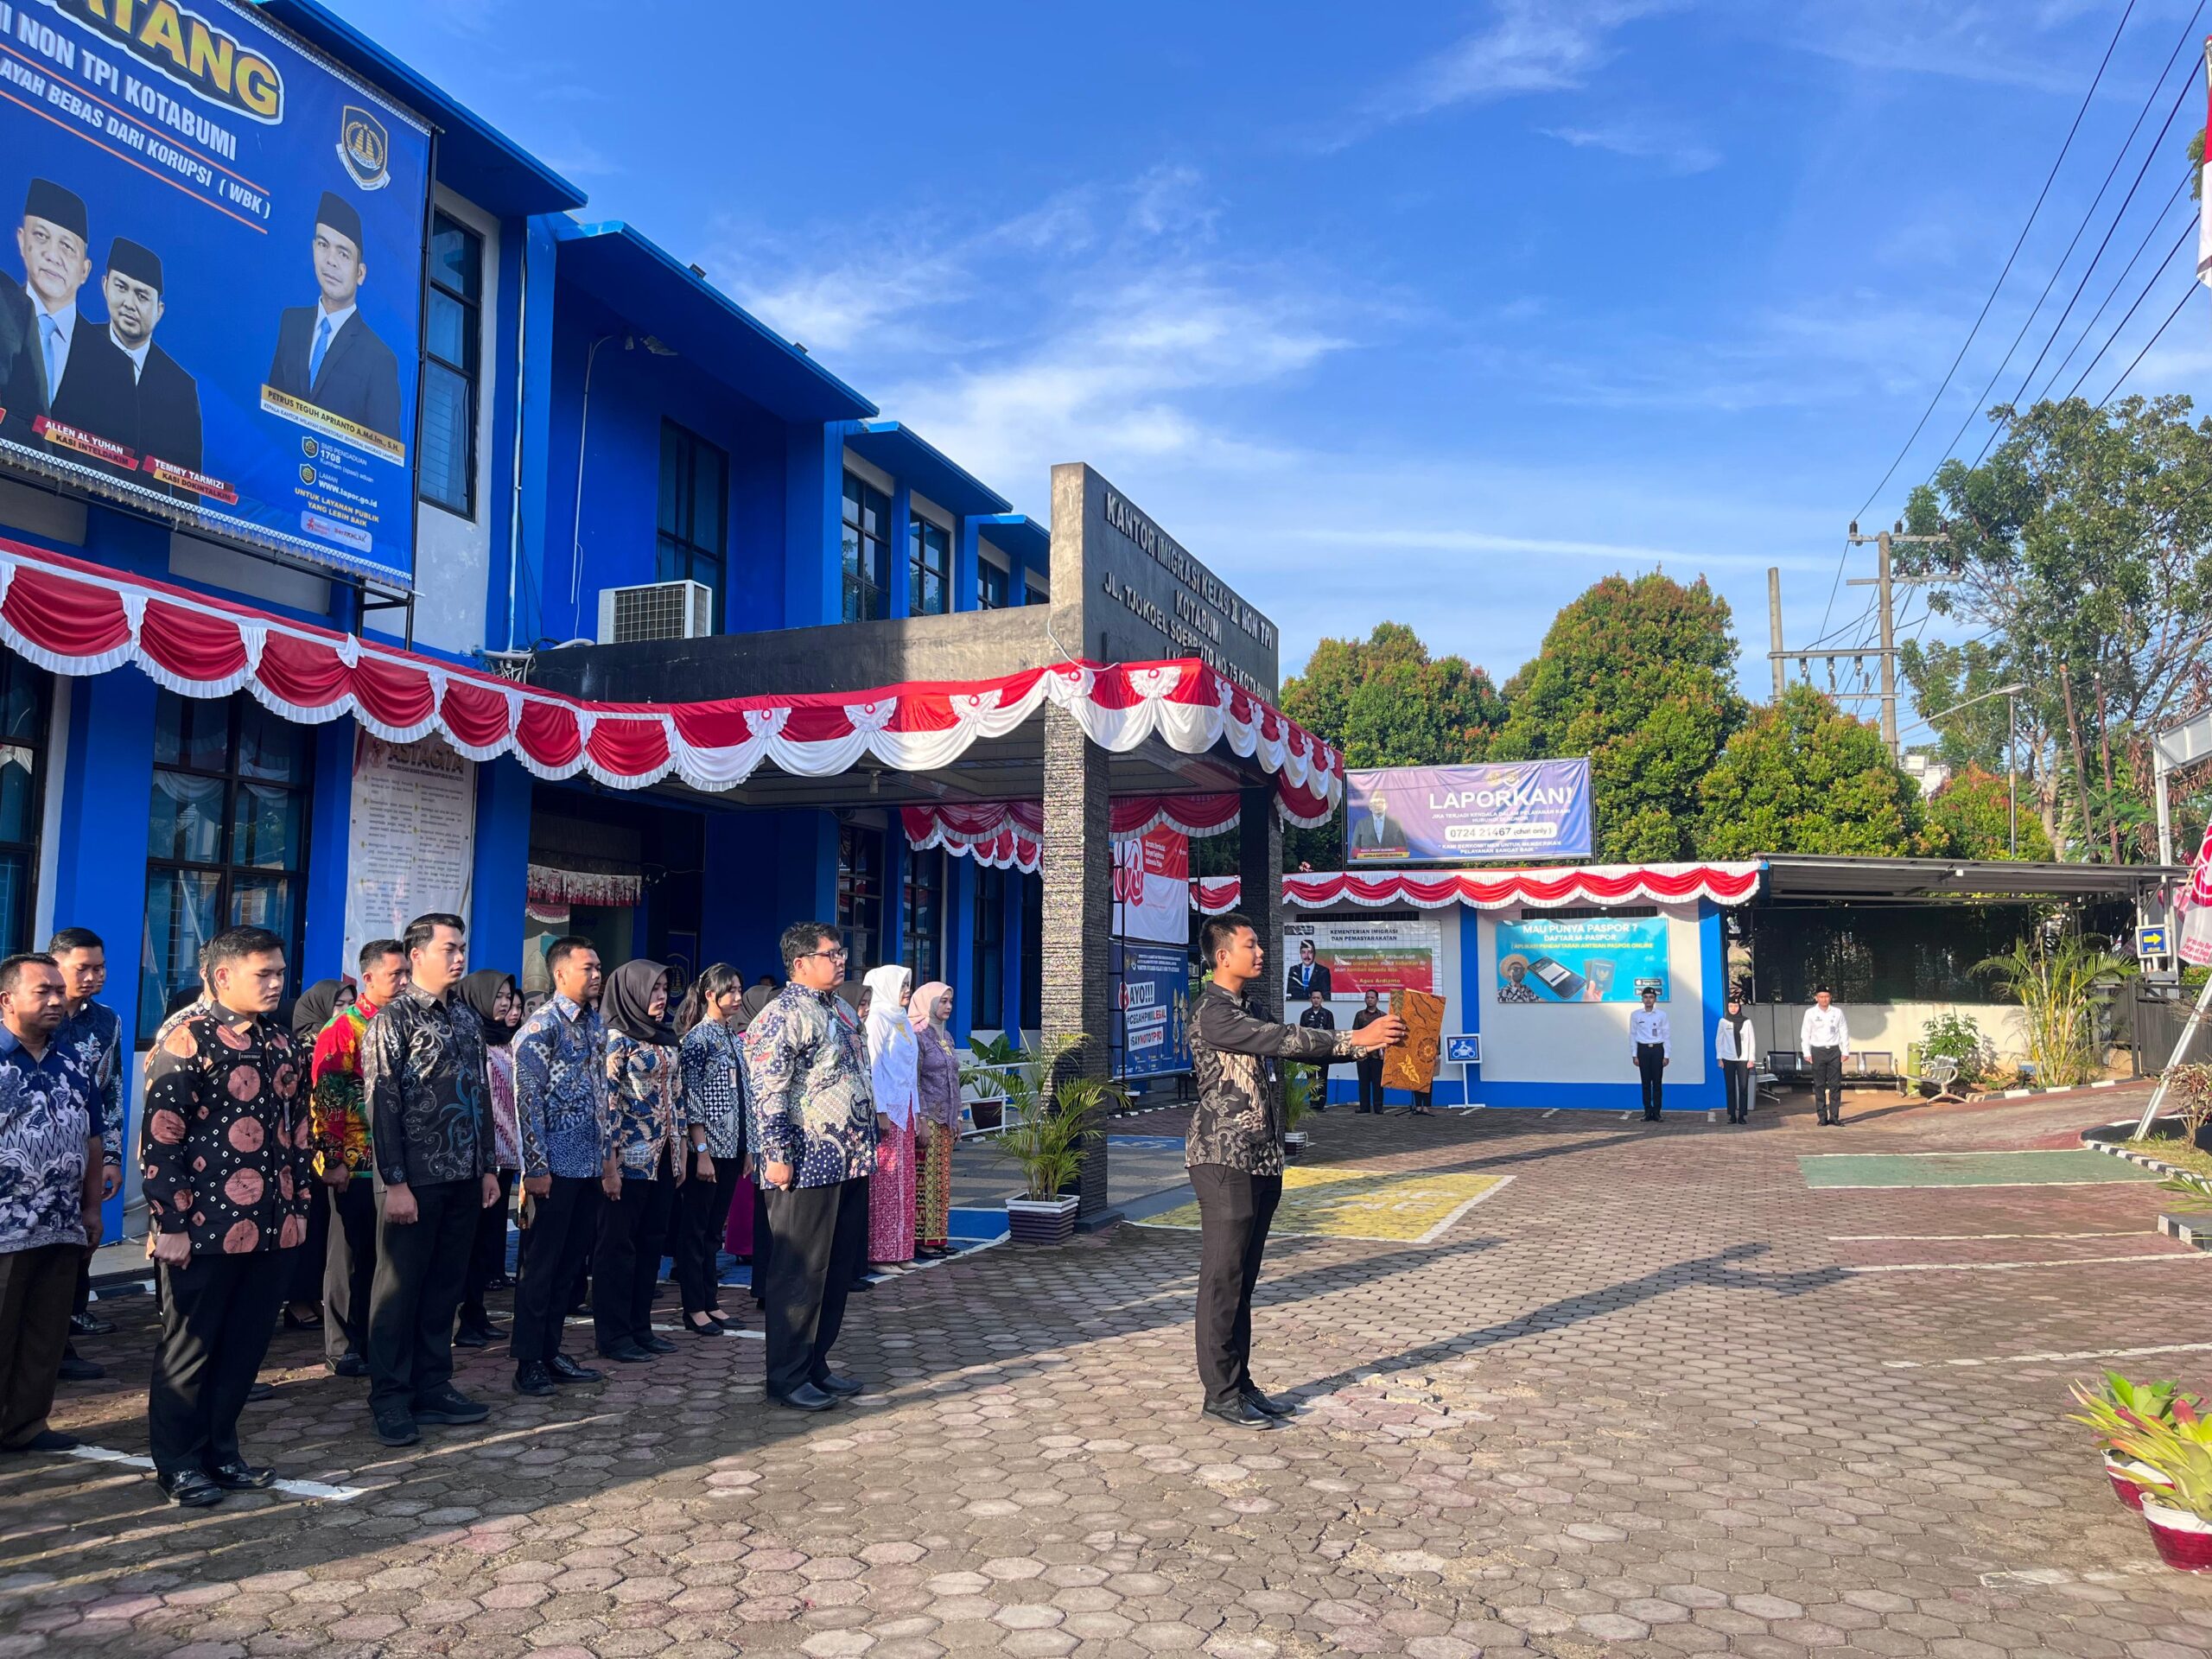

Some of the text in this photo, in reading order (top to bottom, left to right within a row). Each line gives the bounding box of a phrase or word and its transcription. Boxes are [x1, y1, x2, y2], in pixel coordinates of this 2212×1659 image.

[18, 11, 75, 71] NON
[82, 48, 119, 96] TPI
[125, 74, 237, 162] KOTABUMI
[48, 83, 105, 128] BEBAS
[105, 115, 145, 152] DARI
[147, 138, 213, 188] KORUPSI
[268, 390, 294, 407] PETRUS
[296, 401, 320, 418] TEGUH
[321, 413, 355, 432] APRIANTO
[45, 421, 124, 454] ALLEN AL YUHAN
[55, 434, 129, 465] KASI INTELDAKIM
[321, 449, 341, 464] 1708
[334, 447, 367, 467] PENGADUAN
[154, 458, 225, 490] TEMMY TARMIZI
[162, 473, 231, 501] KASI DOKINTALKIM
[319, 471, 339, 484] LAMAN
[295, 486, 379, 524] UNTUK LAYANAN PUBLIK
[308, 500, 367, 527] YANG LEBIH BAIK
[1107, 492, 1154, 556] KANTOR
[1158, 535, 1199, 594] IMIGRASI
[1202, 574, 1228, 616] KELAS
[1242, 606, 1257, 639] NON
[1261, 621, 1272, 650] TPI
[1176, 590, 1222, 646] KOTABUMI
[1105, 572, 1122, 601] JL.
[1126, 585, 1168, 635] TJOKOEL
[1229, 662, 1237, 683] 75
[1239, 669, 1273, 707] KOTABUMI
[1429, 787, 1573, 810] LAPORKAN!
[1450, 829, 1476, 838] 0724
[1522, 923, 1638, 934] MAU PUNYA PASPOR ?
[1130, 983, 1153, 1005] AYO!!!
